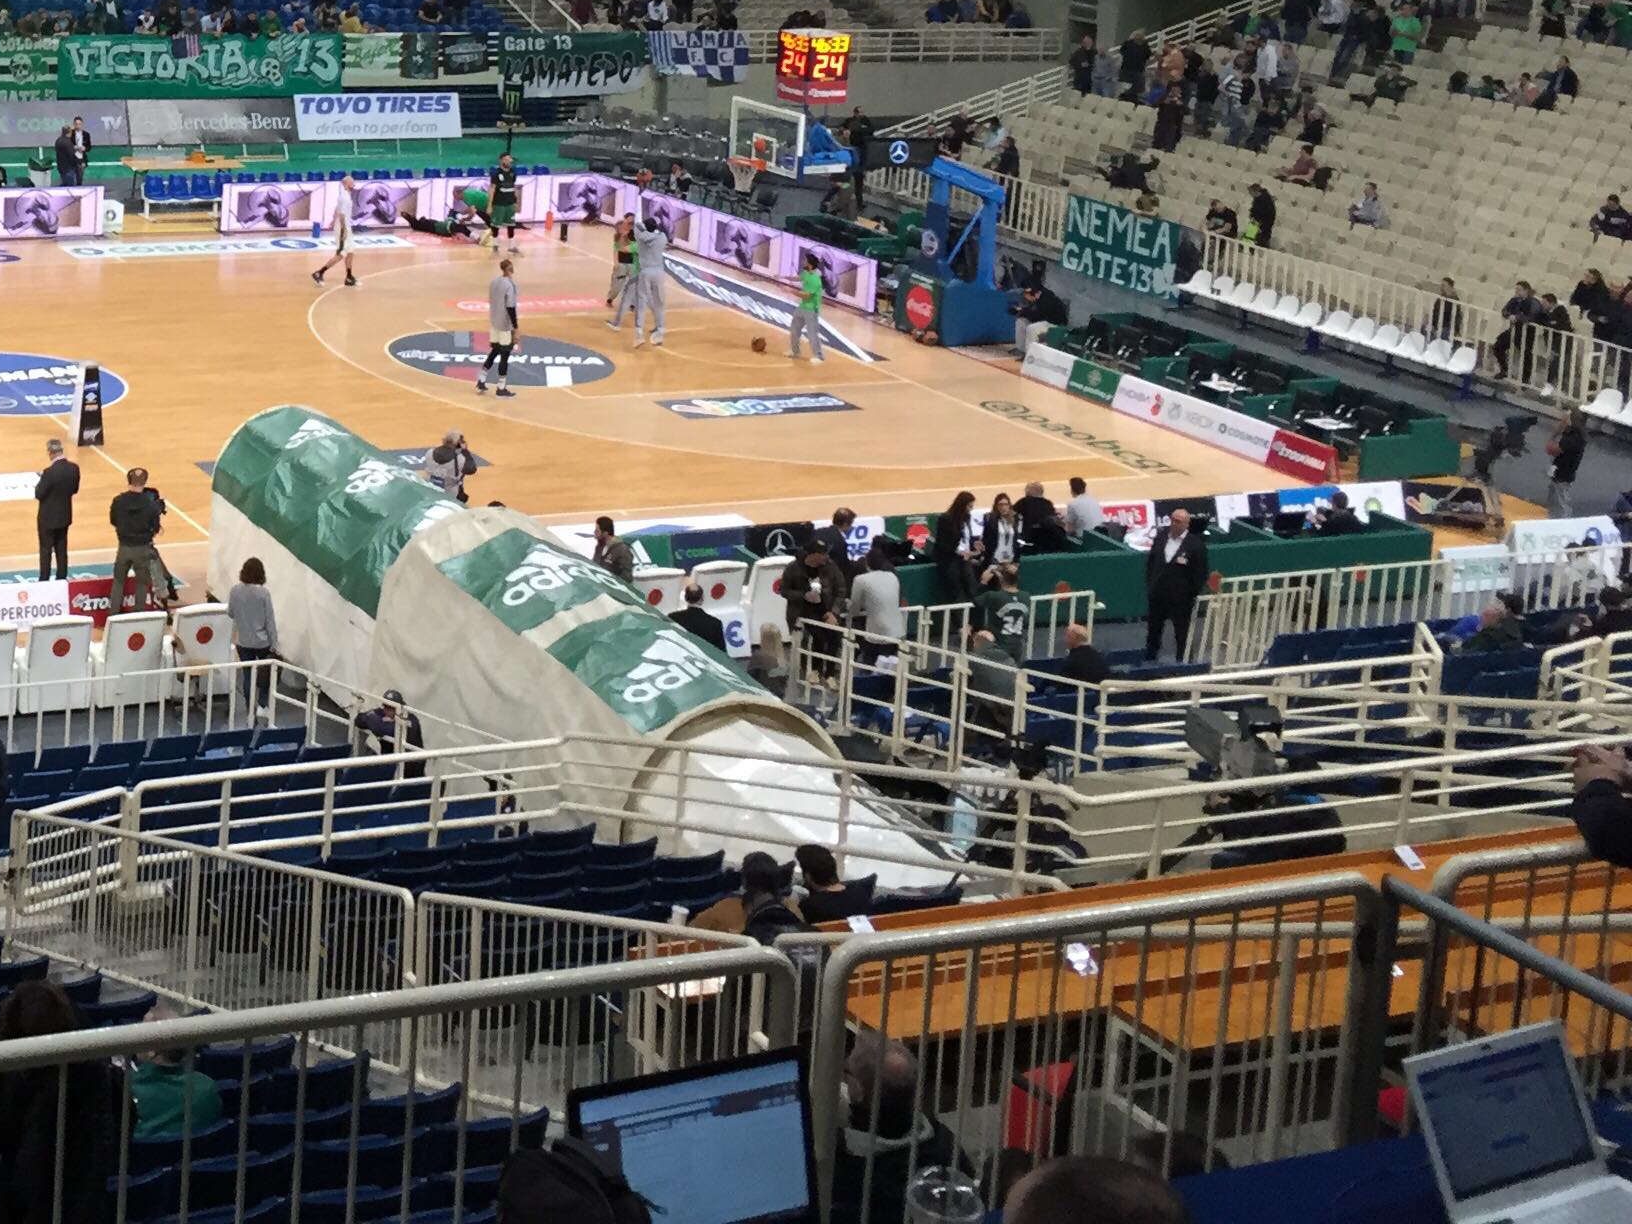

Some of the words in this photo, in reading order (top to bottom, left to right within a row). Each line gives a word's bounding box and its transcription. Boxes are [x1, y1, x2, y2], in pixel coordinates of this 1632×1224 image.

[504, 36, 546, 51] Gate
[553, 34, 573, 50] 13
[293, 37, 340, 82] 13
[781, 49, 807, 76] 24
[813, 55, 845, 79] 24
[300, 97, 372, 114] TOYO
[376, 95, 452, 113] TIRES
[101, 116, 122, 130] TV
[315, 119, 361, 135] driven
[364, 123, 378, 135] to
[380, 121, 439, 137] perform
[1067, 195, 1172, 264] NEMEA
